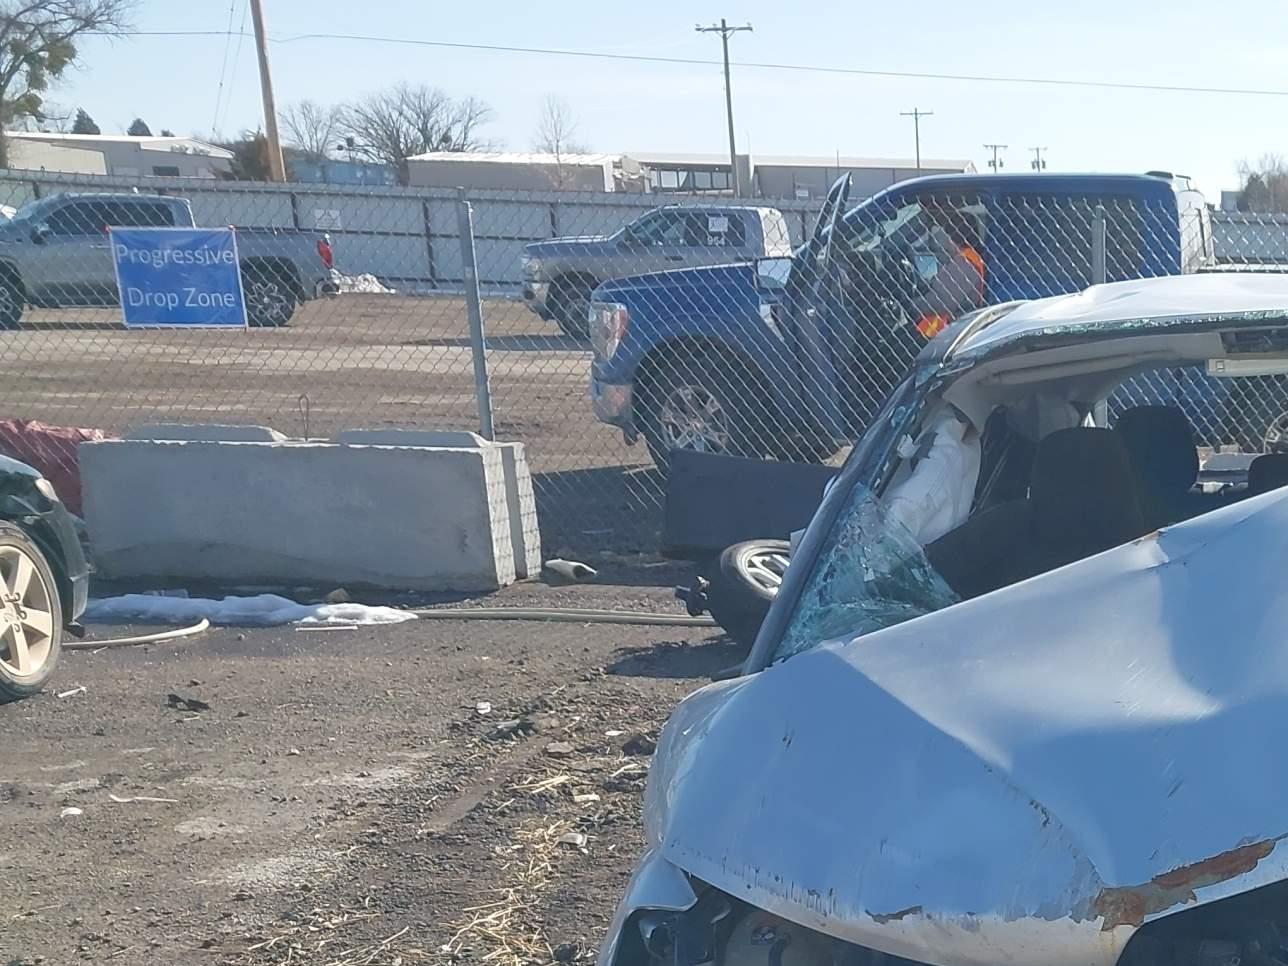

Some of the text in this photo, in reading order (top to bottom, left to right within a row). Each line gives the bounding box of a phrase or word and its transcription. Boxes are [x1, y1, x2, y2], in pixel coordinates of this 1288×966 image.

[116, 244, 235, 269] Progressive
[127, 287, 236, 311] Drop Zone
